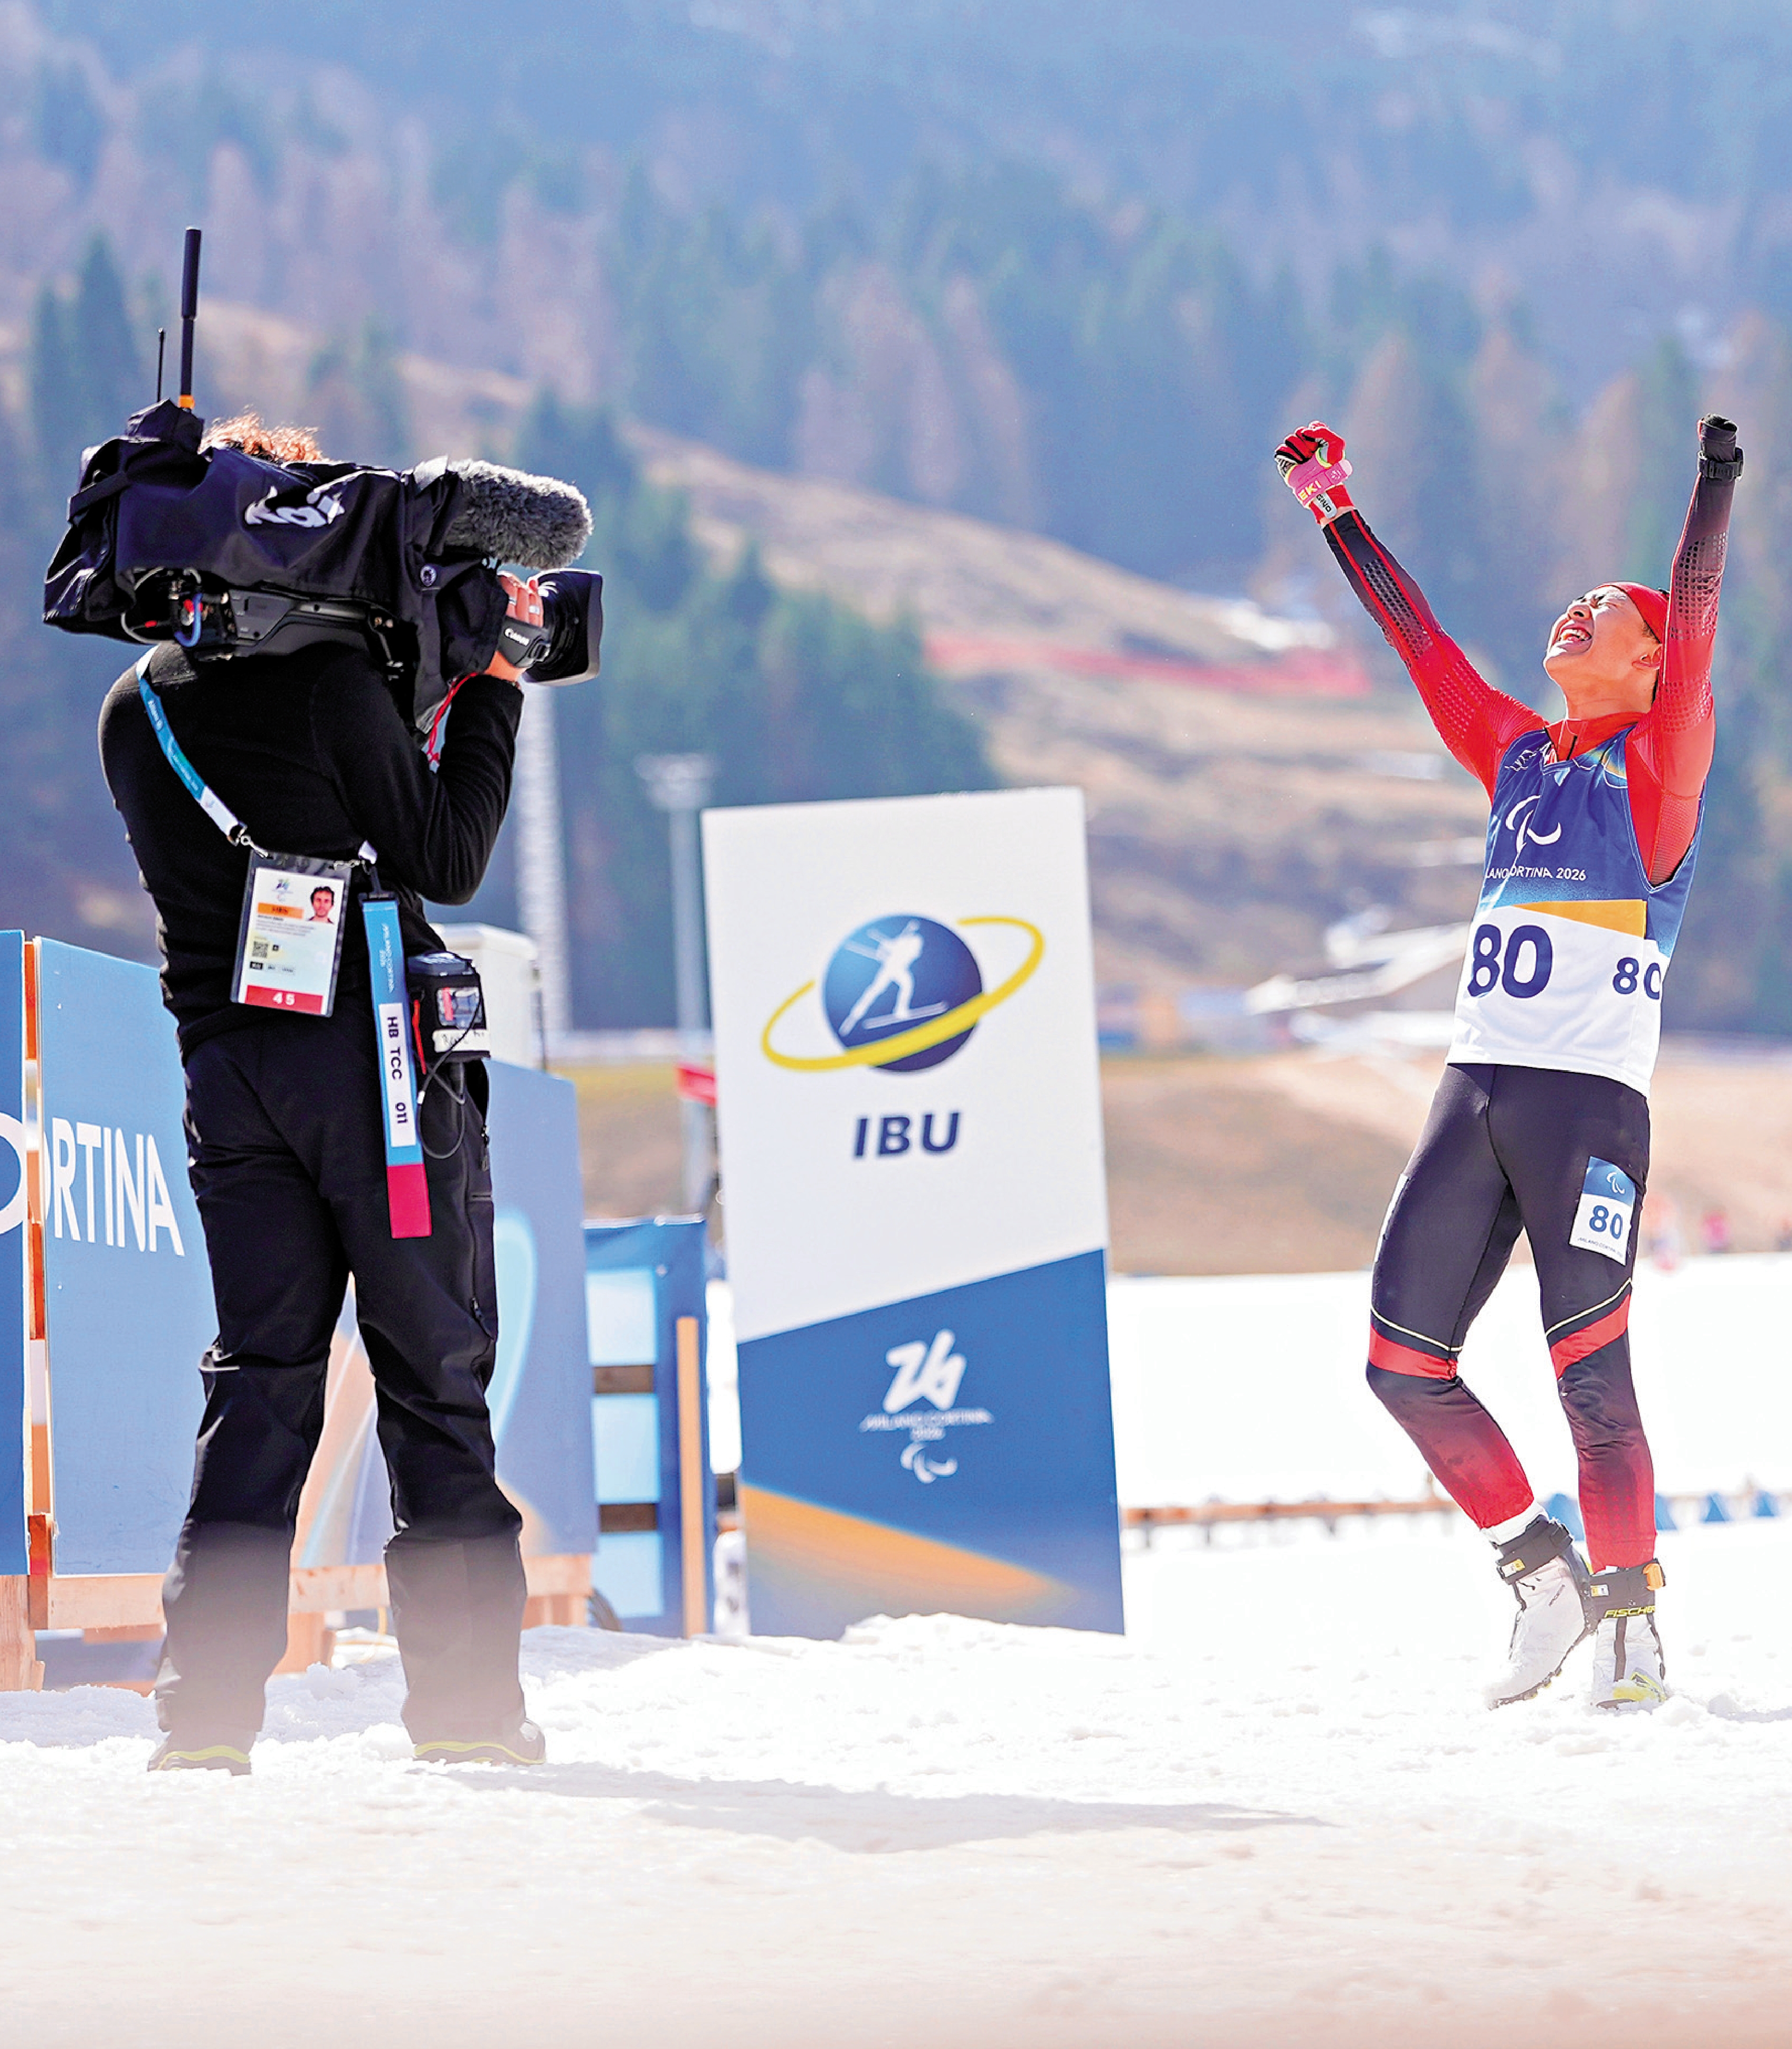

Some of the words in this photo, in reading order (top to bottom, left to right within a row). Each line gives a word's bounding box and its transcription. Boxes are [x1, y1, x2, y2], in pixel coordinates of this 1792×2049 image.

[1556, 867, 1587, 881] 2026
[1467, 923, 1553, 999] 80
[387, 1016, 399, 1038] HB
[390, 1046, 403, 1080] TCC
[394, 1102, 408, 1125] 011
[852, 1111, 962, 1160] IBU
[1589, 1205, 1623, 1240] 80
